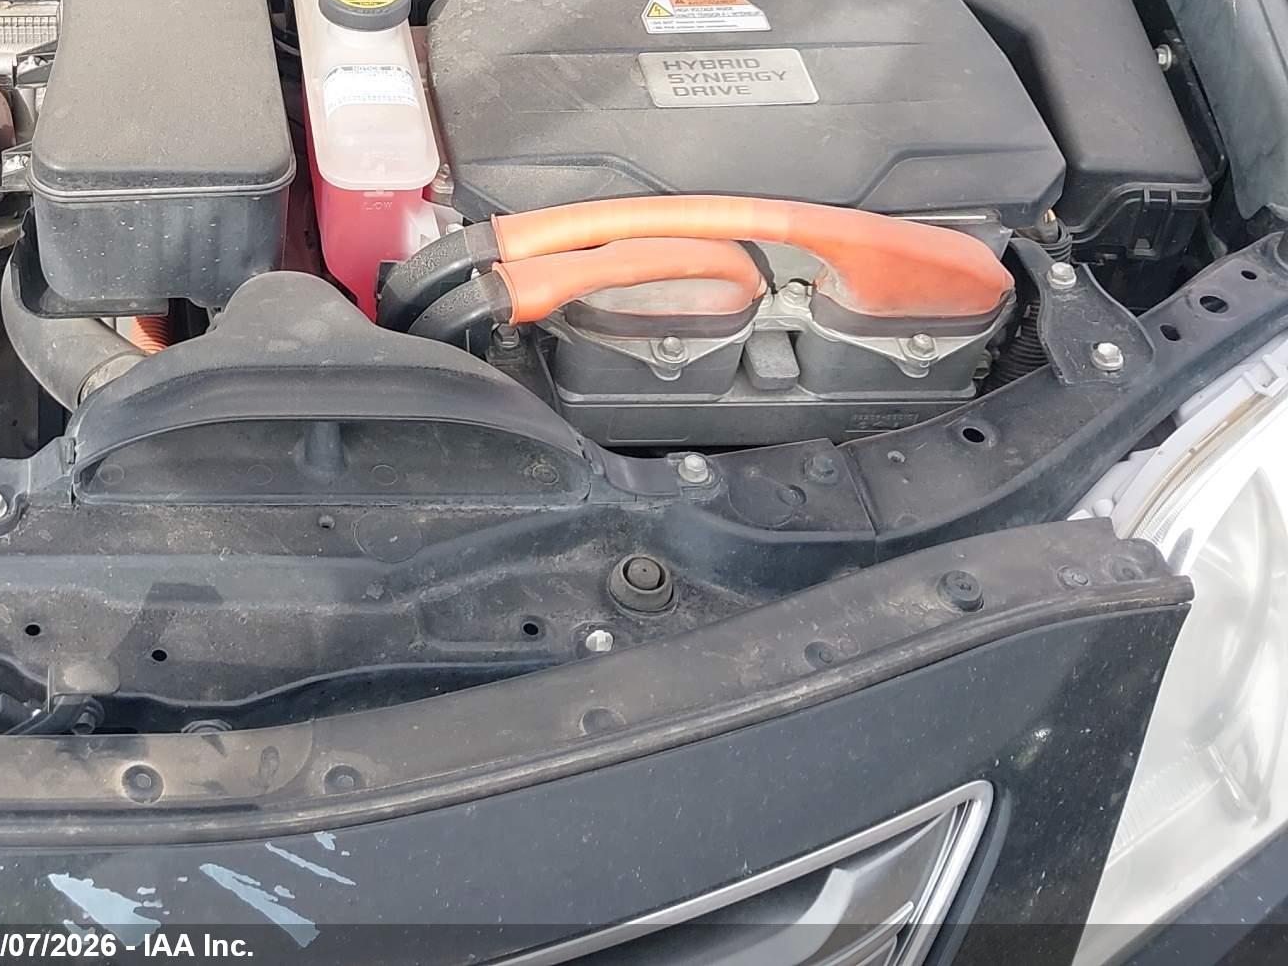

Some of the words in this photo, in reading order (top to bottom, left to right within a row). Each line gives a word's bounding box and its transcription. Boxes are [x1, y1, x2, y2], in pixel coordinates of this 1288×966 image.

[663, 57, 760, 71] HYBRID
[667, 70, 787, 84] SYNERGY
[672, 85, 753, 97] DRIVE
